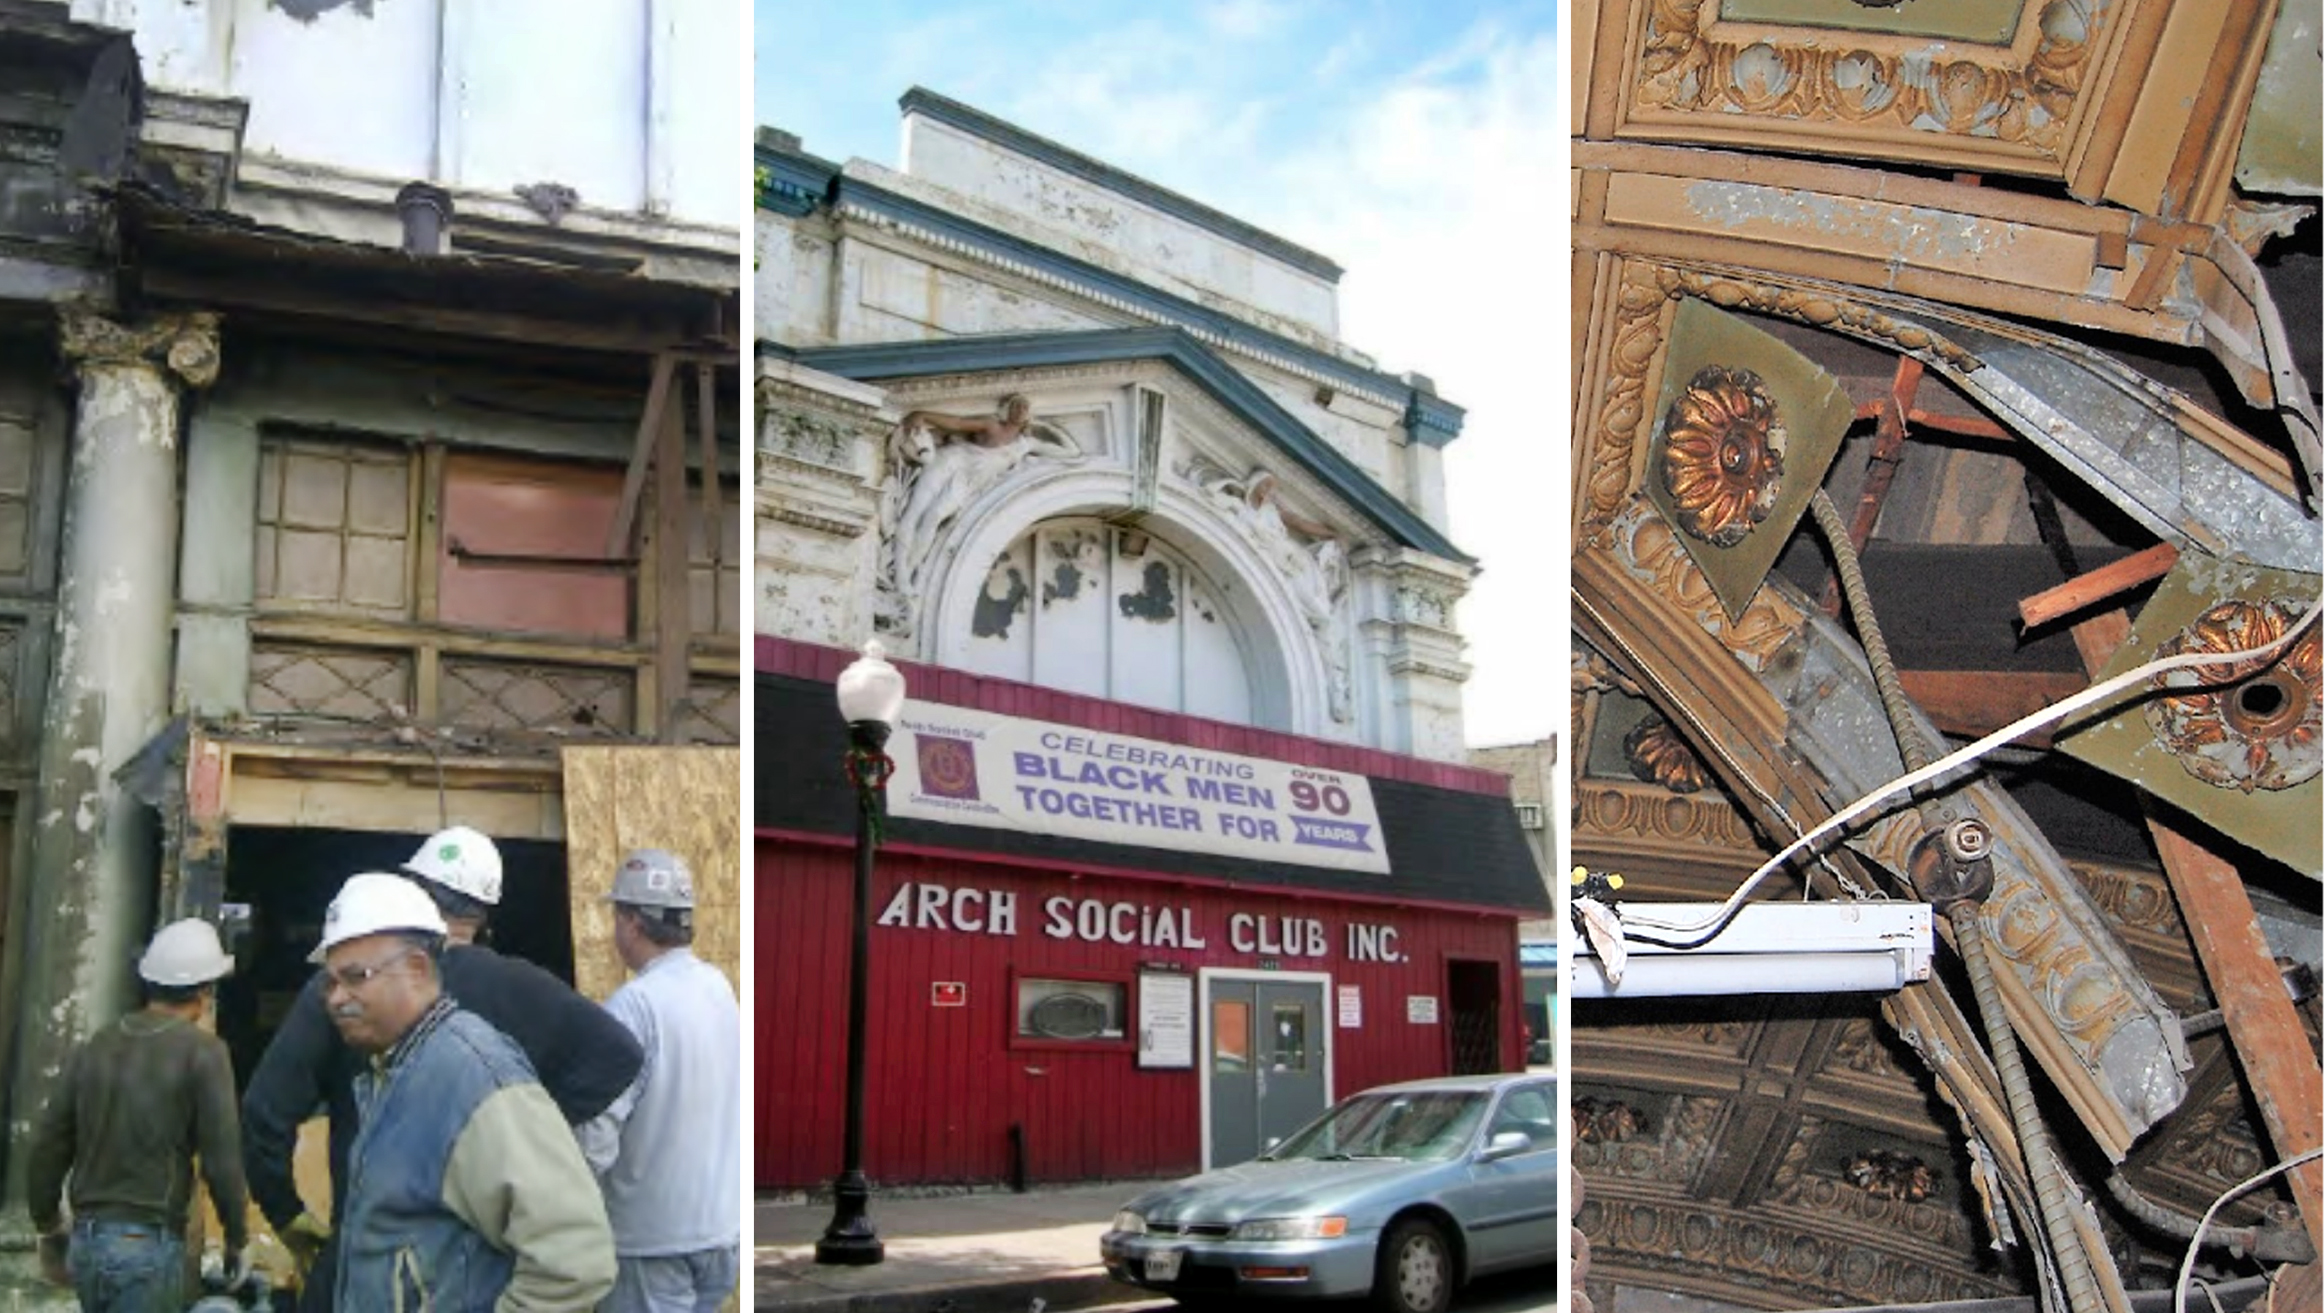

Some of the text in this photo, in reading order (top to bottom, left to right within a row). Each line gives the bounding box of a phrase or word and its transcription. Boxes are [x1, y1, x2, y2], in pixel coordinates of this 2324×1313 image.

[1040, 732, 1255, 780] CELEBRATING
[1291, 768, 1343, 785] OVER
[1013, 751, 1276, 811] BLACK MEN
[1289, 780, 1351, 817] 90
[1014, 784, 1202, 832] TOGETHER
[1218, 812, 1280, 843] FOR
[1300, 823, 1359, 844] YEARS
[876, 881, 1018, 936] ARCH
[1230, 912, 1329, 957] CLUB
[1348, 922, 1409, 963] INC.
